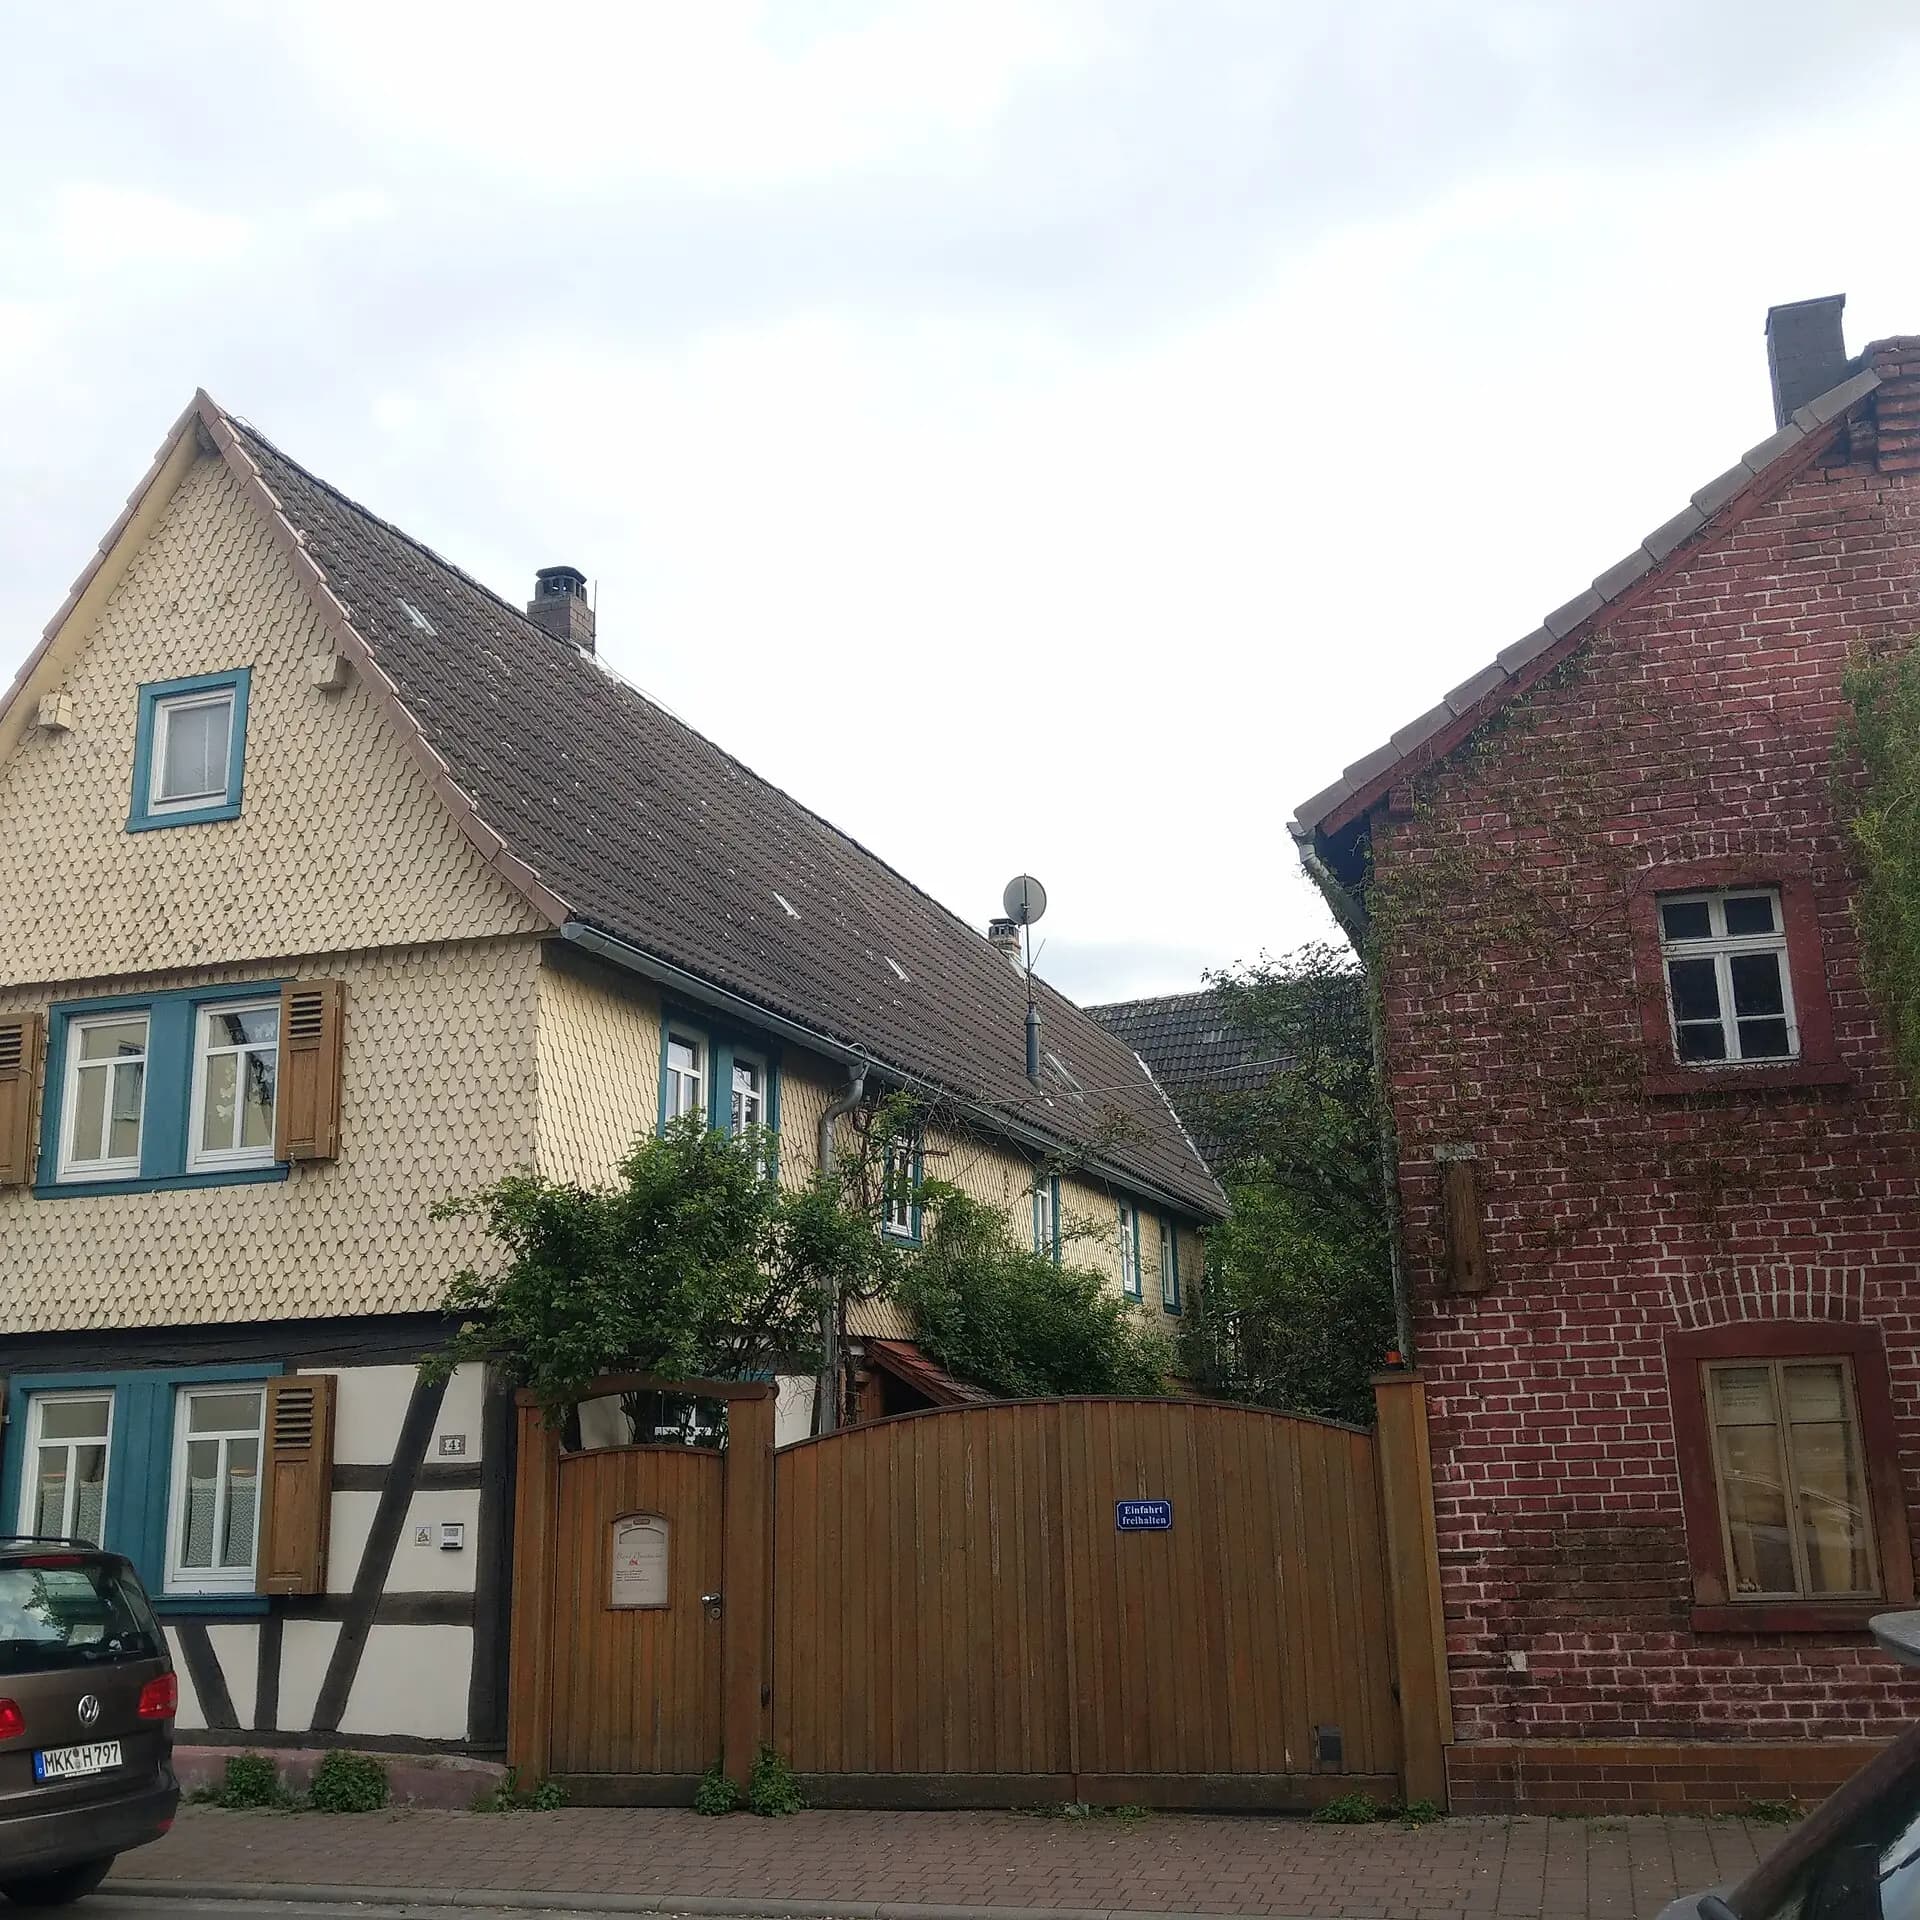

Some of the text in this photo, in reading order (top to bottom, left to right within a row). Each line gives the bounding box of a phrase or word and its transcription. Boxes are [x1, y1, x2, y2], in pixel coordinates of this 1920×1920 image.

[448, 1439, 457, 1450] 4
[1124, 1505, 1163, 1515] Einfahrt
[1122, 1516, 1167, 1525] freihalten
[44, 1750, 74, 1774] MKK
